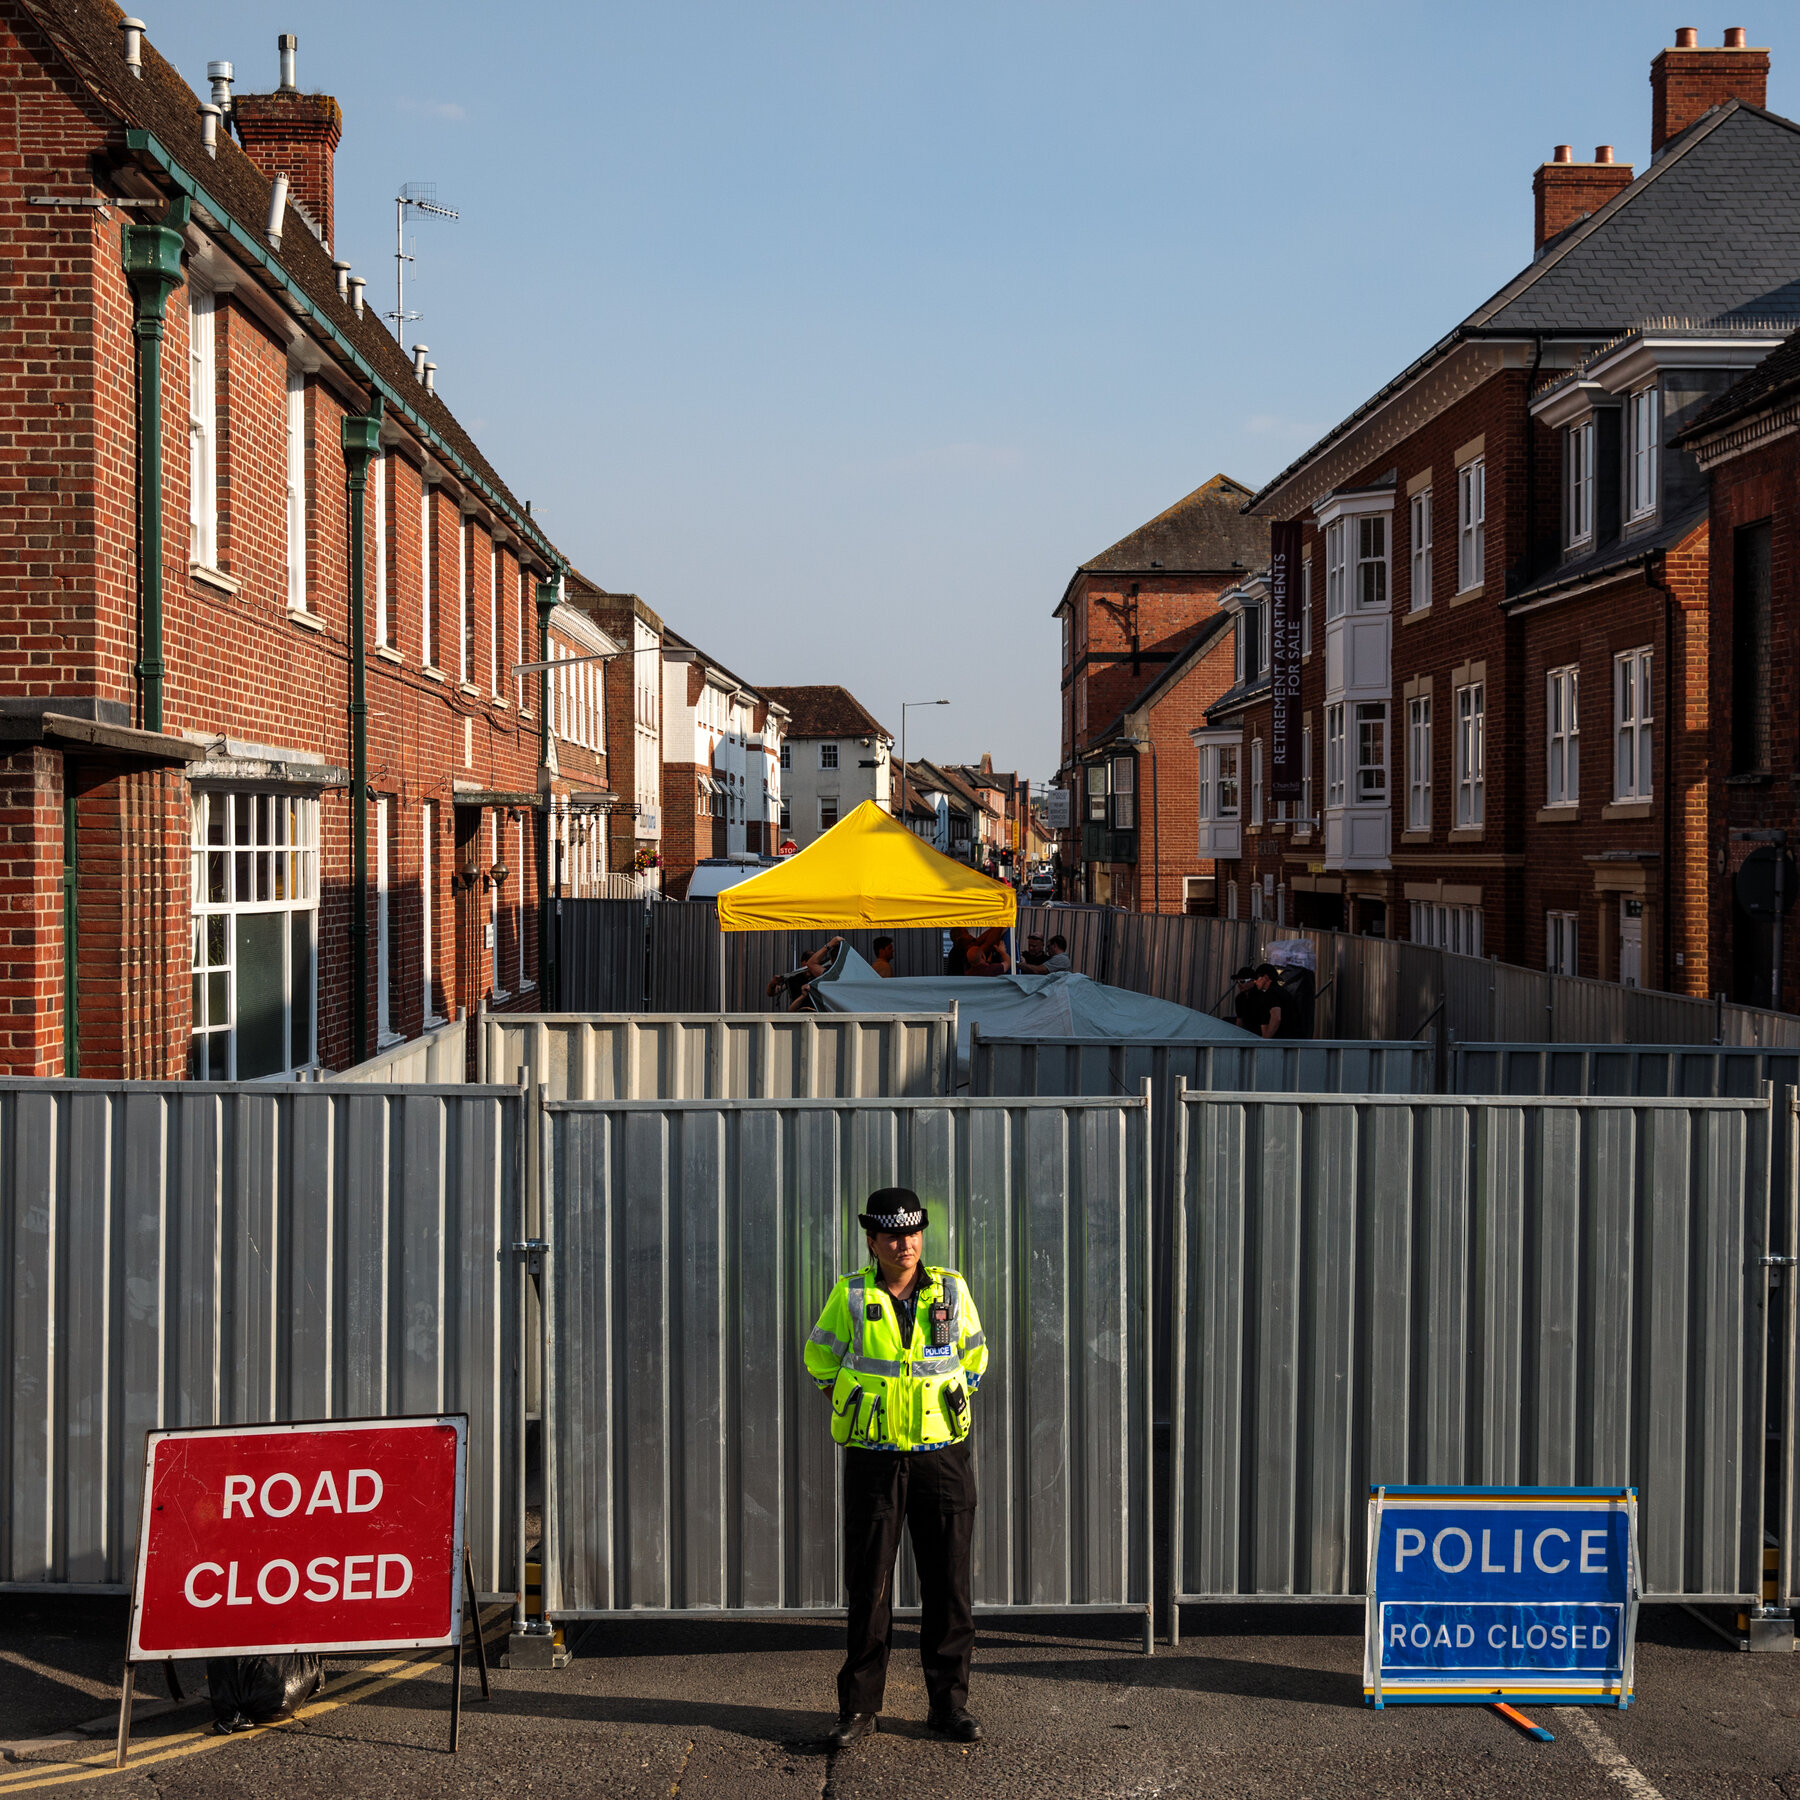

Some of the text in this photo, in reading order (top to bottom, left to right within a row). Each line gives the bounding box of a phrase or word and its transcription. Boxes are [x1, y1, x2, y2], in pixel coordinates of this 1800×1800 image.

[1273, 553, 1286, 765] RETIREMENT APARTMENTS
[1288, 621, 1300, 696] FOR SALE
[925, 1346, 950, 1356] POLICE
[222, 1468, 384, 1519] ROAD
[1395, 1527, 1609, 1574] POLICE
[184, 1553, 413, 1608] CLOSED
[1389, 1623, 1611, 1649] ROAD CLOSED
